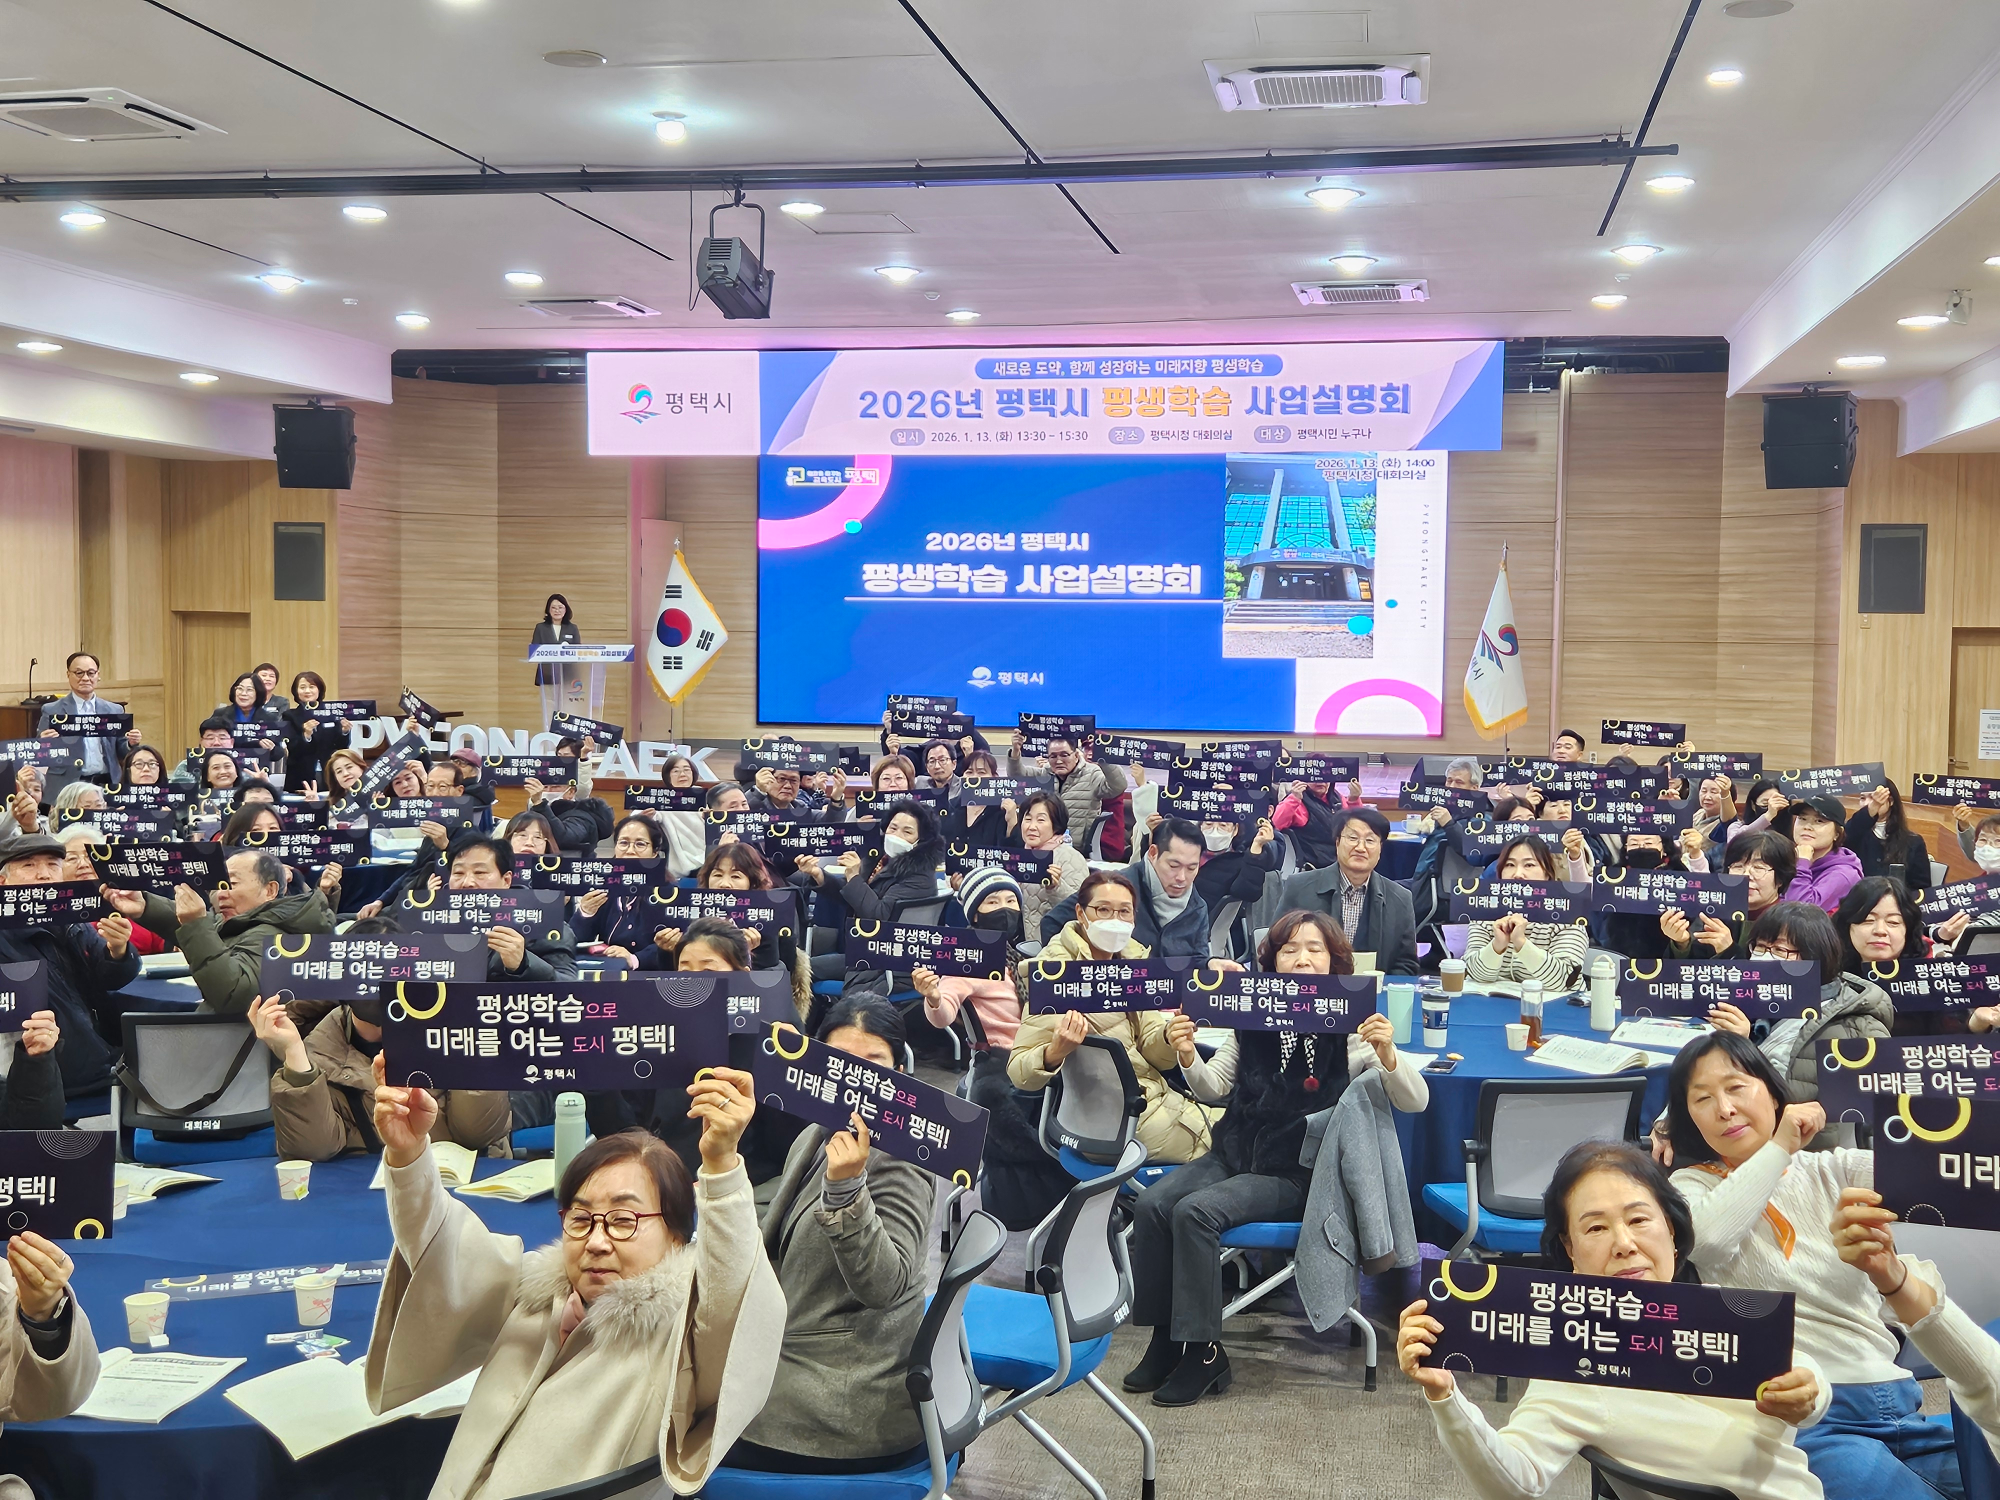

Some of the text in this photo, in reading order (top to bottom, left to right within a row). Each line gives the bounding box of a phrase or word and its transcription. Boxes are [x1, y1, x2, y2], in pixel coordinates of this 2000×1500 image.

[994, 358, 1264, 377] 새로운 도약, 함께 성장하는 미래지향 평생학습
[665, 392, 732, 414] 평택시
[859, 382, 1412, 419] 2026년 평택시 평생학습 사업설명회
[897, 431, 919, 444] 일시
[931, 431, 959, 443] 2026.
[979, 431, 992, 443] 13.
[995, 430, 1013, 443] (화)
[1017, 430, 1045, 442] 13:30
[1059, 430, 1088, 441] 15:30
[1114, 430, 1138, 442] 장소
[1150, 429, 1190, 442] 평택시청
[1193, 429, 1233, 442] 대회의실
[1260, 428, 1284, 441] 대상
[1297, 428, 1338, 441] 평택시민
[1341, 427, 1372, 440] 누구나
[1316, 459, 1345, 468] 2026.
[1382, 458, 1401, 468] (화)
[1406, 459, 1435, 467] 14:00
[1324, 470, 1426, 481] 평택시청 대회의실
[926, 532, 1089, 552] 2026년 평택시
[1421, 504, 1429, 588] PYEONGTAEK
[862, 563, 1201, 595] 평생학습 사업설명회
[998, 670, 1045, 686] 평택시
[1606, 802, 1655, 812] 평생학습으로
[1653, 814, 1675, 824] 평택!
[280, 834, 332, 845] 평생학습으로
[800, 826, 844, 837] 평생학습으로
[781, 834, 864, 847] 미래를 여는 평택!
[124, 848, 182, 862] 평생학습으로
[292, 843, 353, 856] 여는 평택!
[108, 861, 208, 878] 미래를 여는 도시 평택!
[571, 862, 624, 873] 평생학습으로
[551, 873, 581, 885] 미래를
[584, 872, 604, 884] 여는
[622, 872, 646, 884] 평택!
[1639, 874, 1701, 889] 평생학습으로
[4, 888, 73, 902] 평생학습으로
[1490, 883, 1547, 896] 평생학습으로
[1614, 887, 1726, 905] 미래를 여는 도시 평택!
[1936, 882, 1988, 900] 평생학습으로
[20, 901, 48, 915] 여는
[51, 902, 67, 912] 도시
[71, 897, 100, 912] 평택!
[449, 894, 517, 908] 평생학습으로
[691, 892, 750, 907] 평생학습으로
[1469, 896, 1570, 911] 미래를 여는 도시 평택!
[1951, 896, 1971, 906] 여는
[422, 909, 542, 924] 미래를 여는 도시 평택!
[666, 906, 774, 921] 미래를 평택!
[894, 928, 958, 946] 평생학습으로
[329, 940, 420, 960] 평생학습으로
[868, 940, 983, 963] 미래를 여는 도시 평택!
[293, 960, 454, 980] 미래를 여는 도시 평택!
[1081, 963, 1148, 981] 평생학습으로
[1680, 964, 1760, 985] 평생학습으로
[1915, 961, 1988, 979] 평생학습으로
[1054, 978, 1173, 998] 미래를 여는 도시 평택!
[1240, 977, 1318, 997] 평생학습으로
[1649, 981, 1793, 1000] 미래를 여는 도시 평택!
[1890, 979, 1984, 996] 미래를 여는 도시
[477, 993, 618, 1024] 평생학습으로
[727, 996, 760, 1013] 평택!
[1112, 1000, 1128, 1008] 평택시
[1209, 994, 1349, 1016] 미래를 여는 도시 평택!
[1276, 1019, 1294, 1027] 평택시
[426, 1025, 675, 1057] 미래를 여는 도시 평택!
[544, 1068, 576, 1080] 평택시
[827, 1055, 917, 1108] 평생학습으로
[1859, 1071, 1977, 1095] 미래를 여는
[785, 1065, 950, 1150] 미래를 여는 도시 평택!
[184, 1119, 221, 1130] 대회의실
[1529, 1281, 1679, 1322] 평생학습으로
[1471, 1310, 1739, 1364] 미래를 여는 도시 평택!
[1597, 1363, 1631, 1378] 평택시
